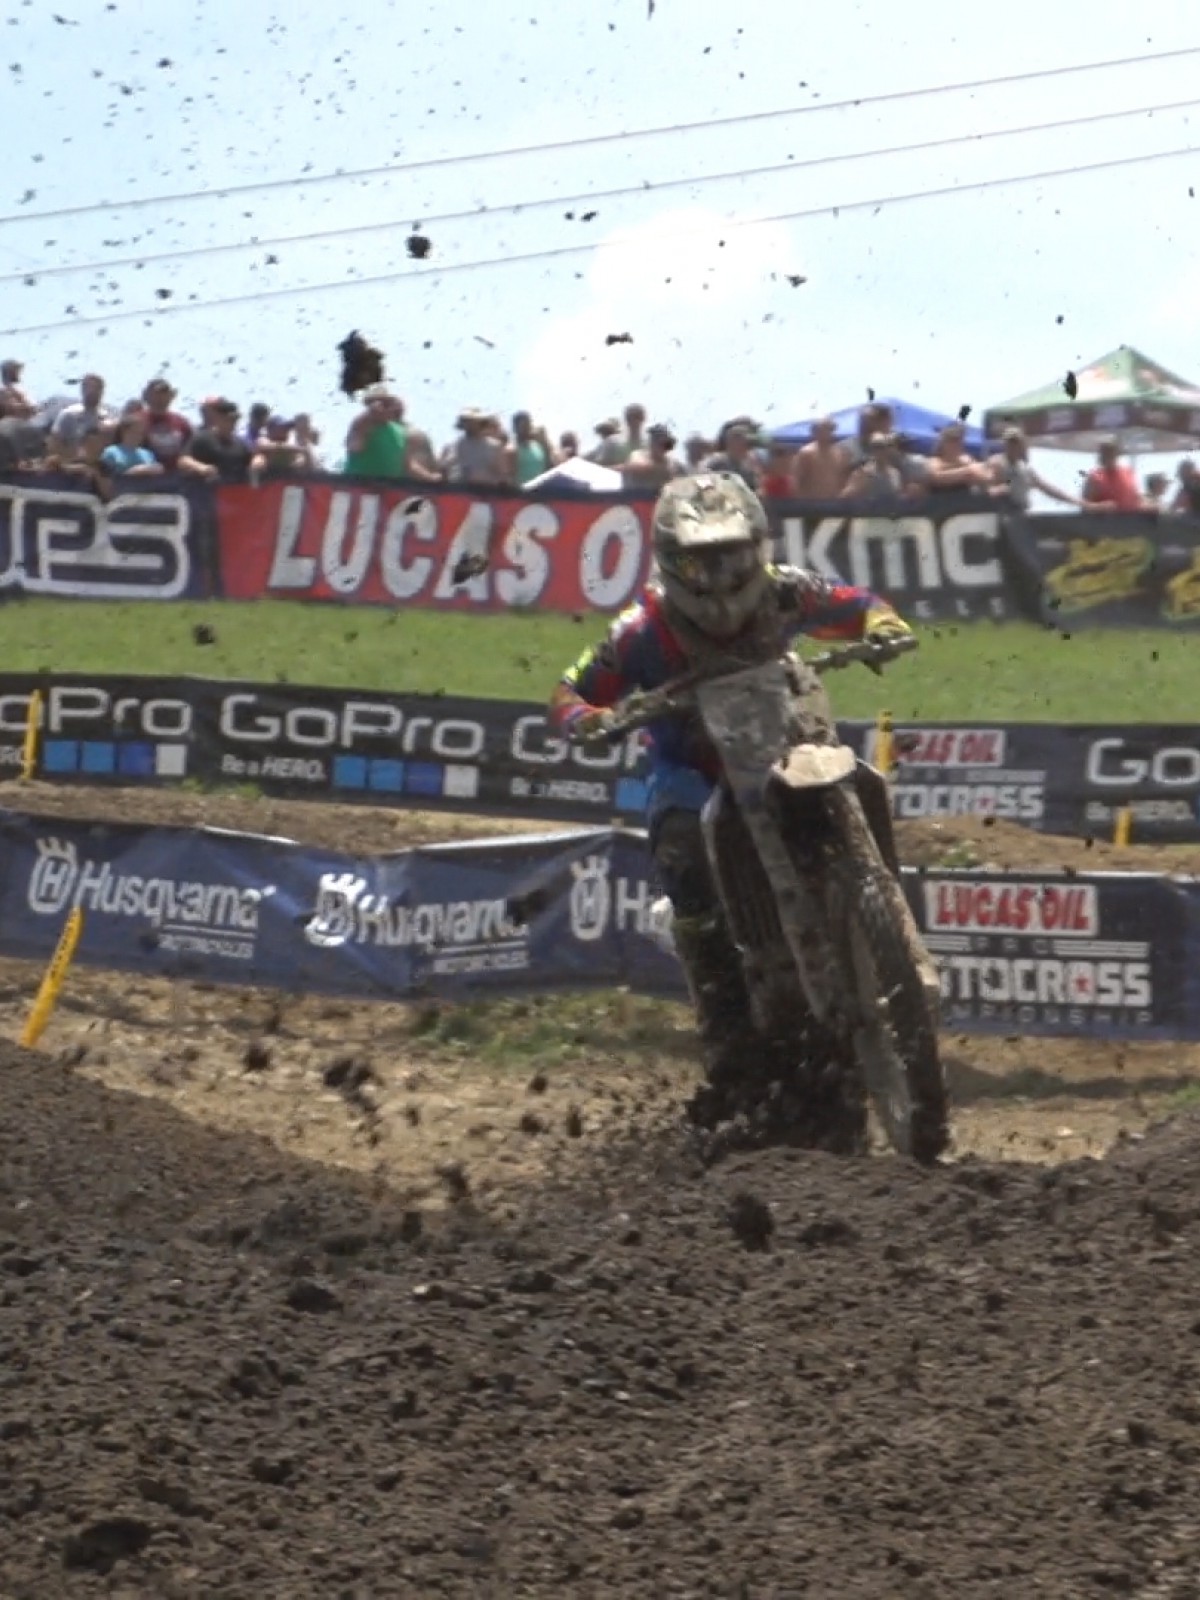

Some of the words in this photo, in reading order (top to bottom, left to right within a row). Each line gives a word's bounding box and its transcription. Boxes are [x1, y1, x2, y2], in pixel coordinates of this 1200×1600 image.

[267, 485, 560, 605] LUCAS
[783, 512, 1002, 589] KMC
[0, 687, 193, 736] oPro
[220, 694, 484, 758] GoPro
[891, 784, 1045, 818] OCROSS
[73, 861, 260, 929] Husqvarna
[935, 885, 1034, 930] LUCAS
[1041, 888, 1089, 931] OIL
[938, 955, 1152, 1008] TOCROSS
